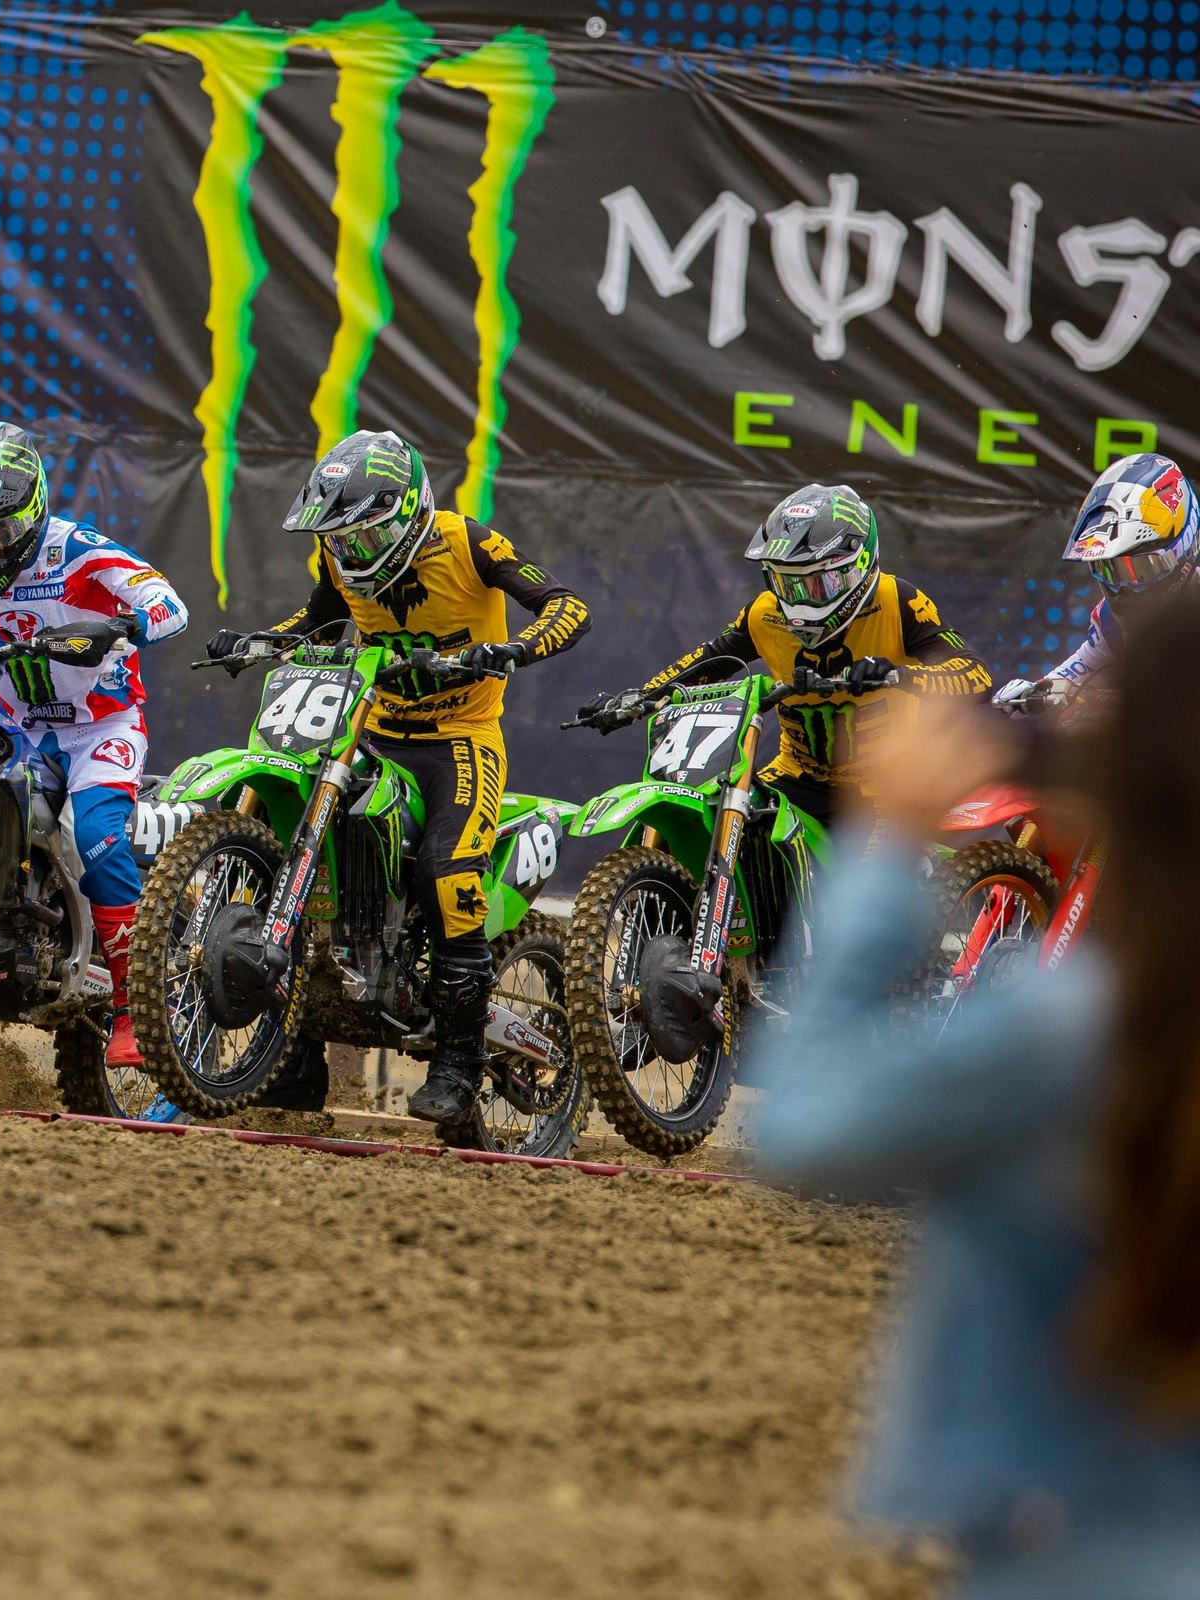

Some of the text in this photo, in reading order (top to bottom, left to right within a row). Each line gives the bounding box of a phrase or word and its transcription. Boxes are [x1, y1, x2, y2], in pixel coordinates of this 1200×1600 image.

[325, 466, 345, 475] BELL
[789, 507, 811, 515] BELL
[388, 521, 421, 568] MONSTER
[1085, 549, 1106, 558] Bull
[27, 585, 65, 599] YAMAHA
[838, 571, 873, 616] MONSTER
[285, 668, 340, 683] LUCAS OIL
[257, 678, 354, 741] 48
[667, 702, 724, 720] LUCAS OIL
[649, 713, 741, 775] 47
[454, 761, 473, 806] SUPER
[291, 848, 313, 897] BRAKING
[515, 823, 557, 887] 48
[261, 860, 291, 941] DUNLOP
[713, 875, 729, 925] BRAKING
[691, 891, 710, 971] DUNLOP
[1047, 891, 1084, 973] DUNLOP
[87, 970, 110, 985] BRAKING
[284, 964, 303, 1036] DUNLOP
[722, 985, 732, 1055] DUNLOP
